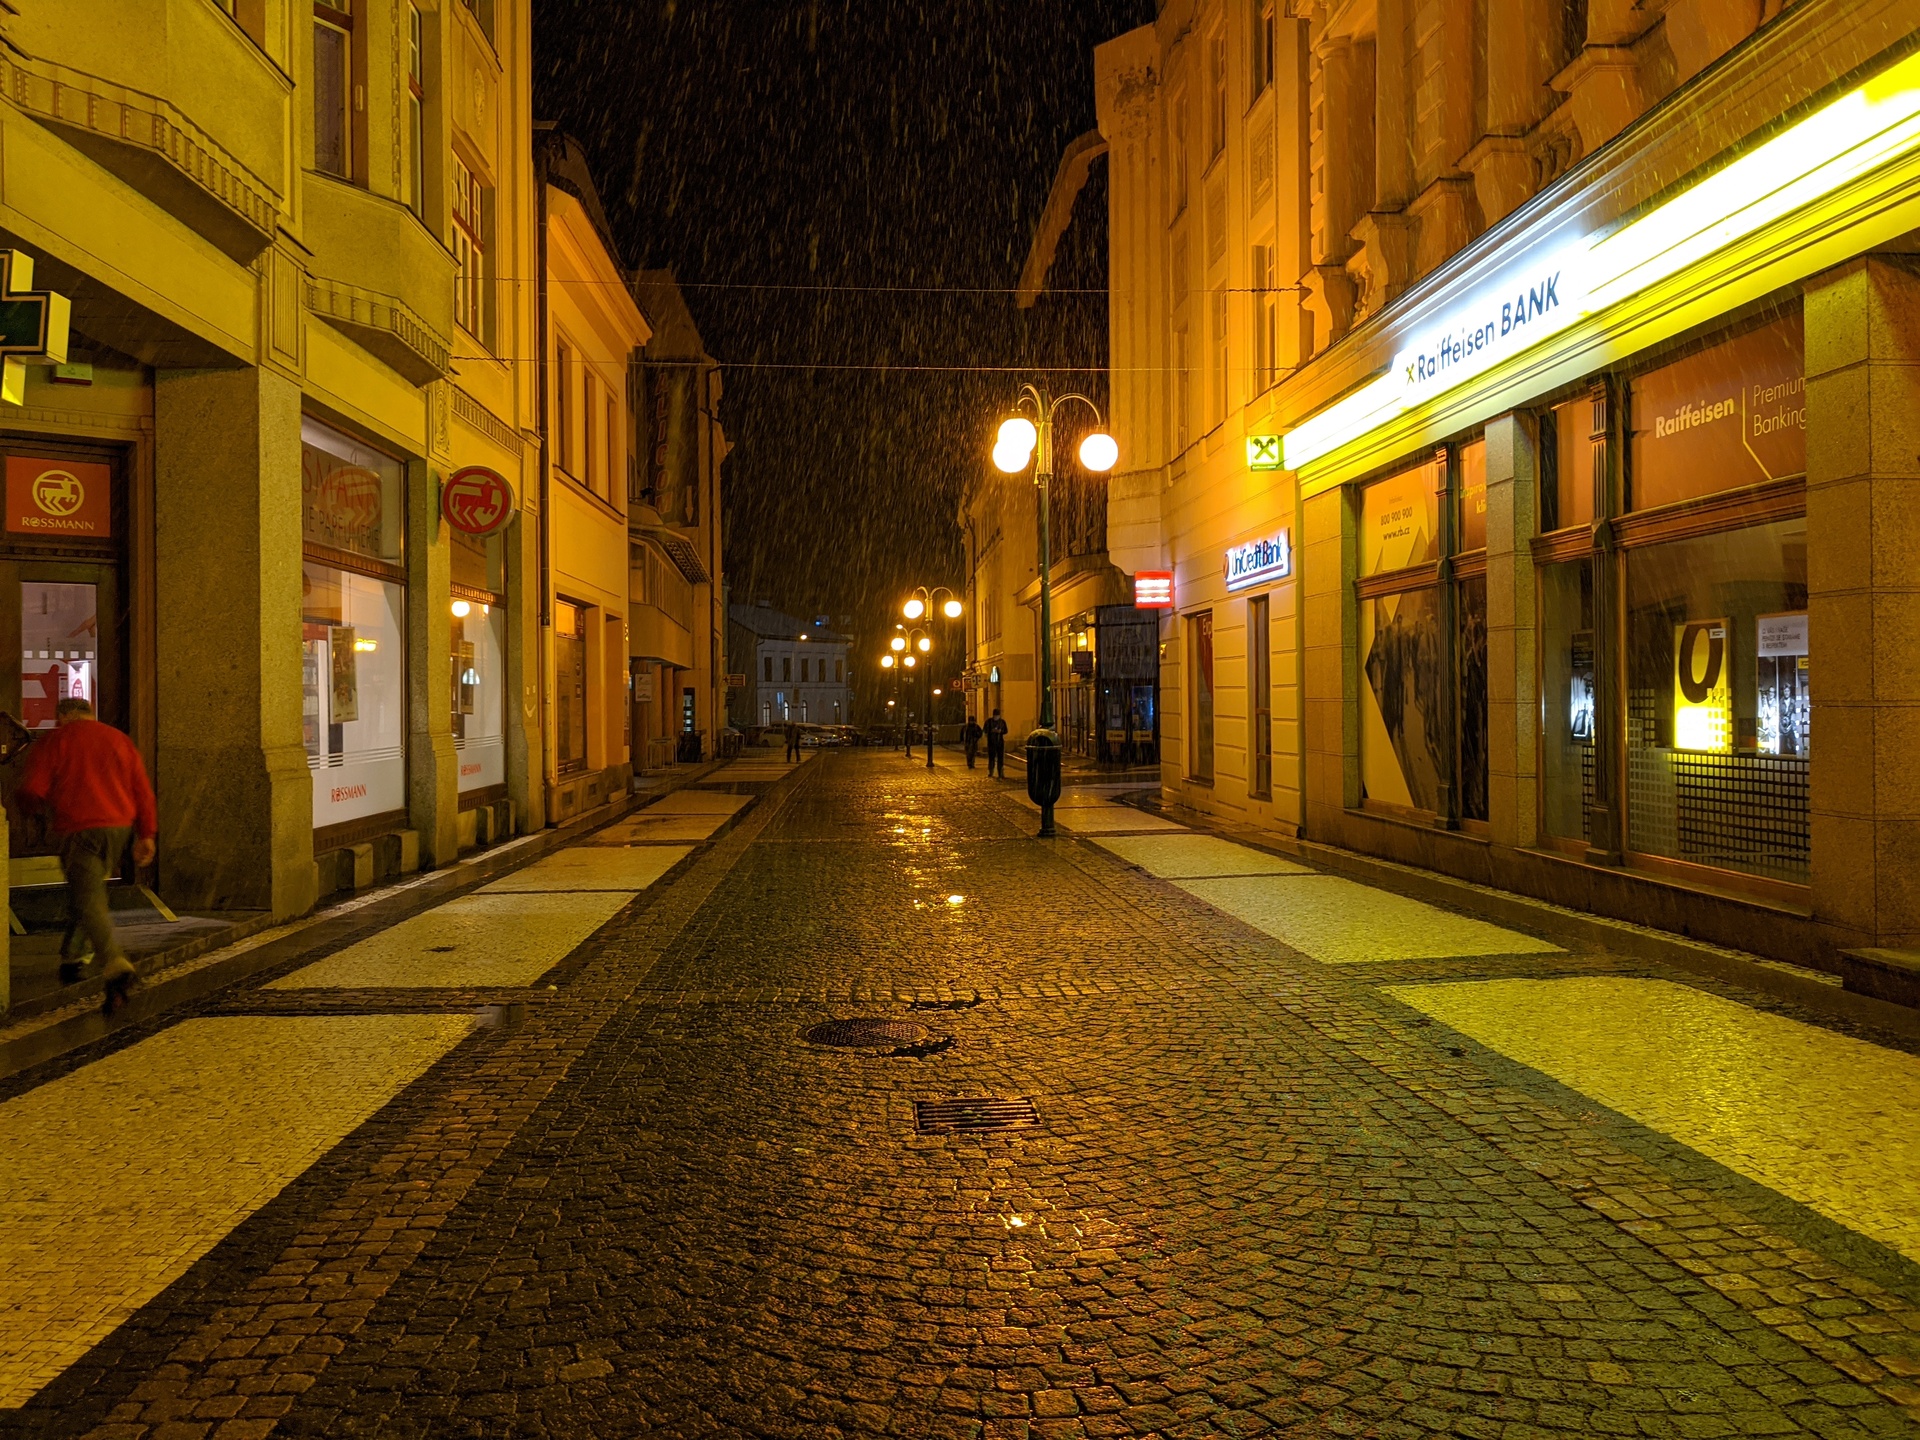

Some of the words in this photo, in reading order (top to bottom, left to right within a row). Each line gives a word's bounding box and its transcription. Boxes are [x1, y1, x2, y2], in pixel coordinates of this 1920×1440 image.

[1418, 321, 1495, 384] Raiffeisen
[1501, 270, 1561, 338] BANK
[1655, 397, 1735, 439] Raiffeisen
[21, 516, 95, 531] ROSSMANN
[1380, 513, 1391, 526] 800
[1391, 510, 1401, 523] 900
[1402, 506, 1413, 520] 900
[1383, 525, 1411, 541] www.rb.cz
[331, 783, 368, 803] ROSSMANN
